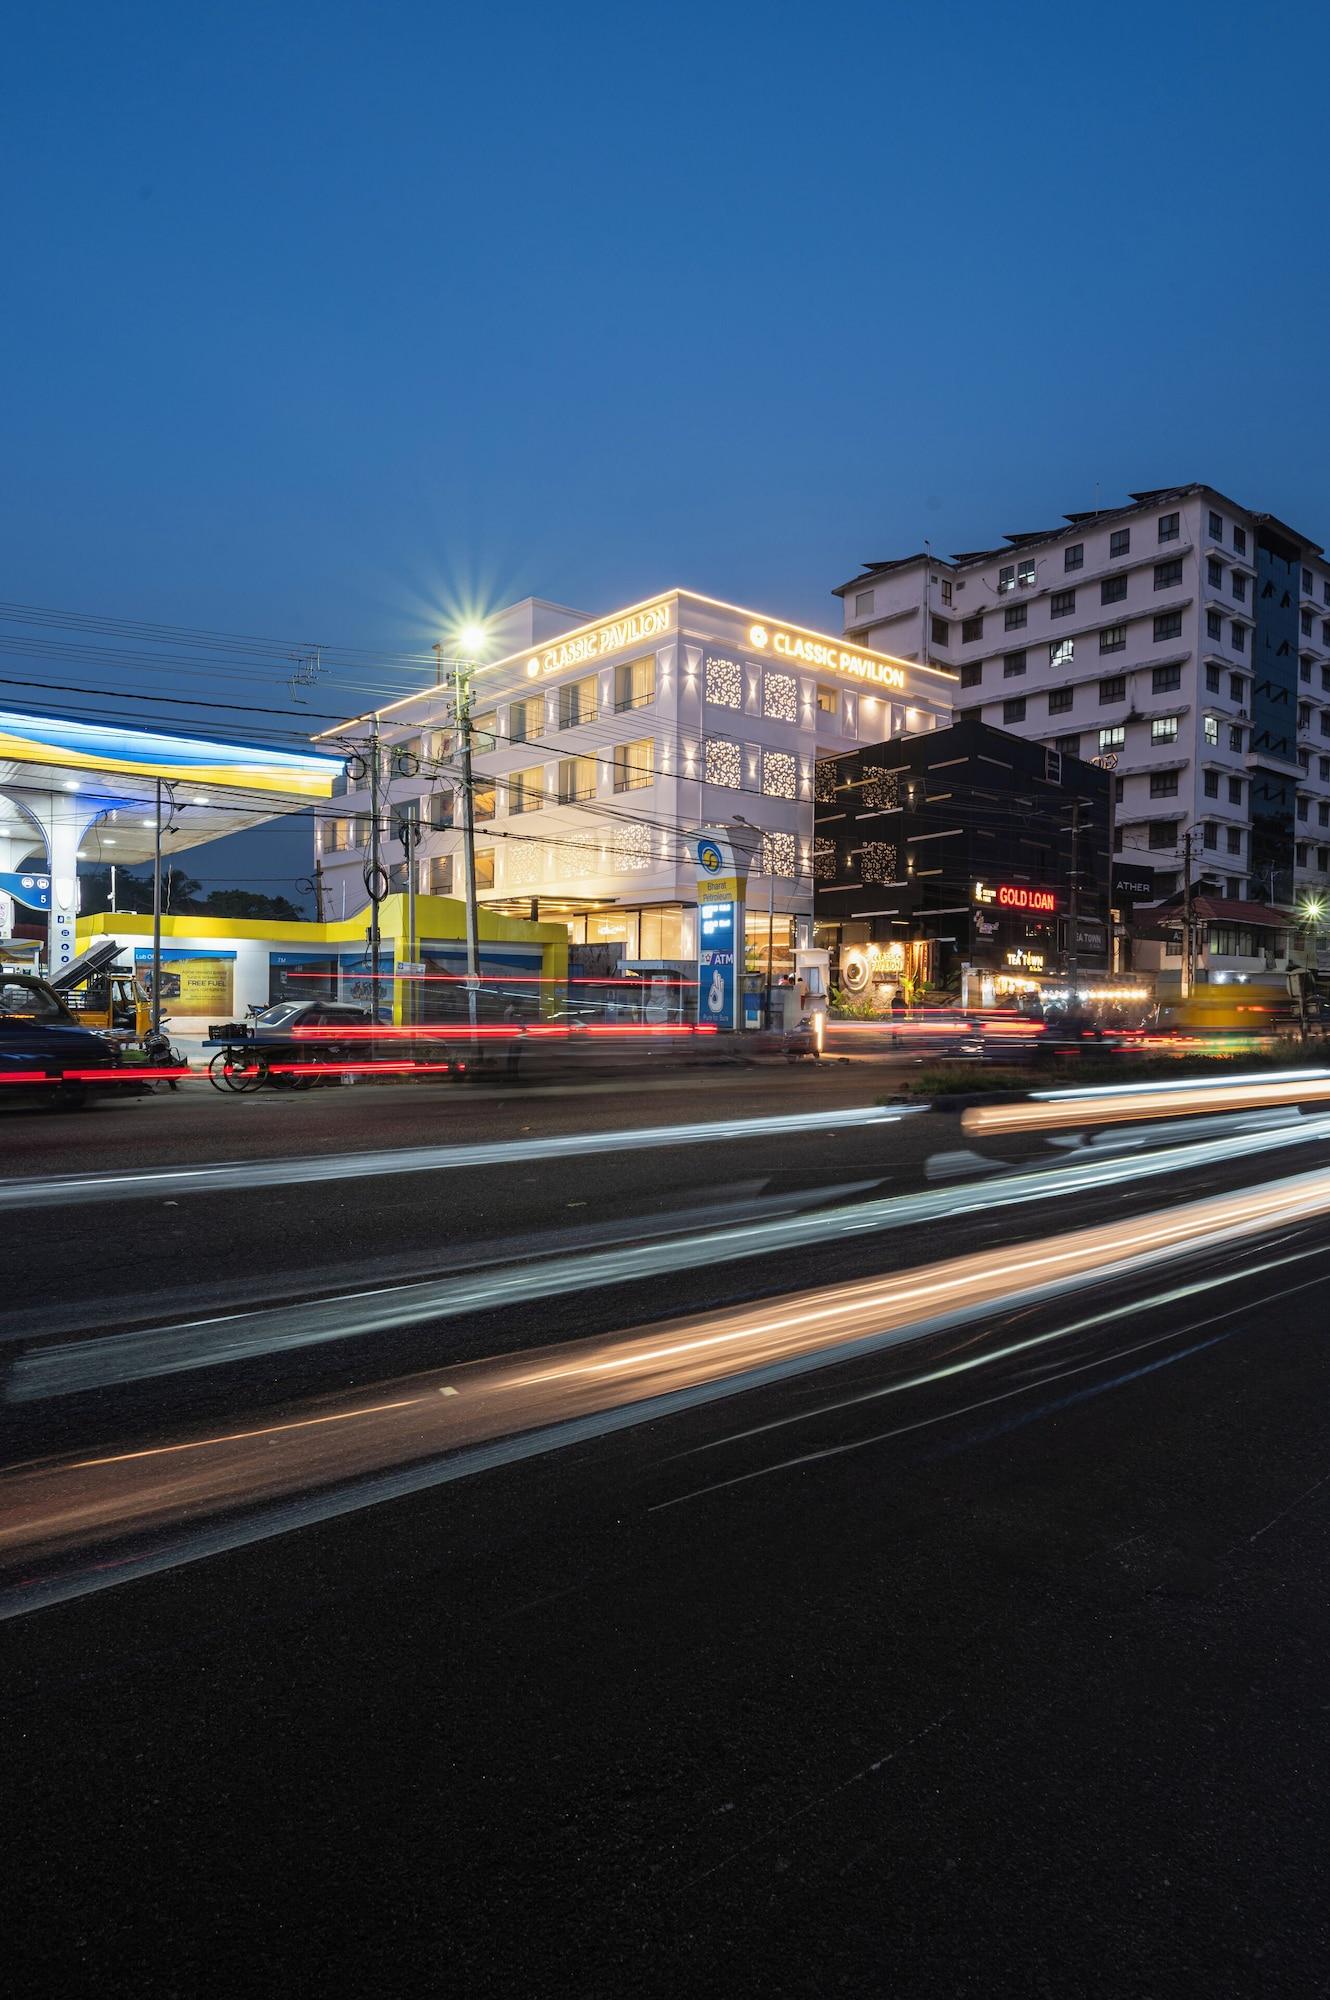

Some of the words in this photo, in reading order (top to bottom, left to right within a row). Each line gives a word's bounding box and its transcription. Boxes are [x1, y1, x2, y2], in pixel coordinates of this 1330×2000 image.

[543, 635, 598, 672] CLASSIC
[600, 607, 670, 650] PAVILION
[773, 633, 838, 669] CLASSIC
[839, 652, 905, 689] PAVILION
[1116, 881, 1151, 893] ATHER
[40, 894, 47, 903] 5
[1000, 887, 1027, 906] GOLD
[1029, 891, 1054, 911] LOAN
[714, 953, 734, 965] ATM
[1006, 952, 1022, 966] TEA
[1022, 951, 1044, 967] TOWN
